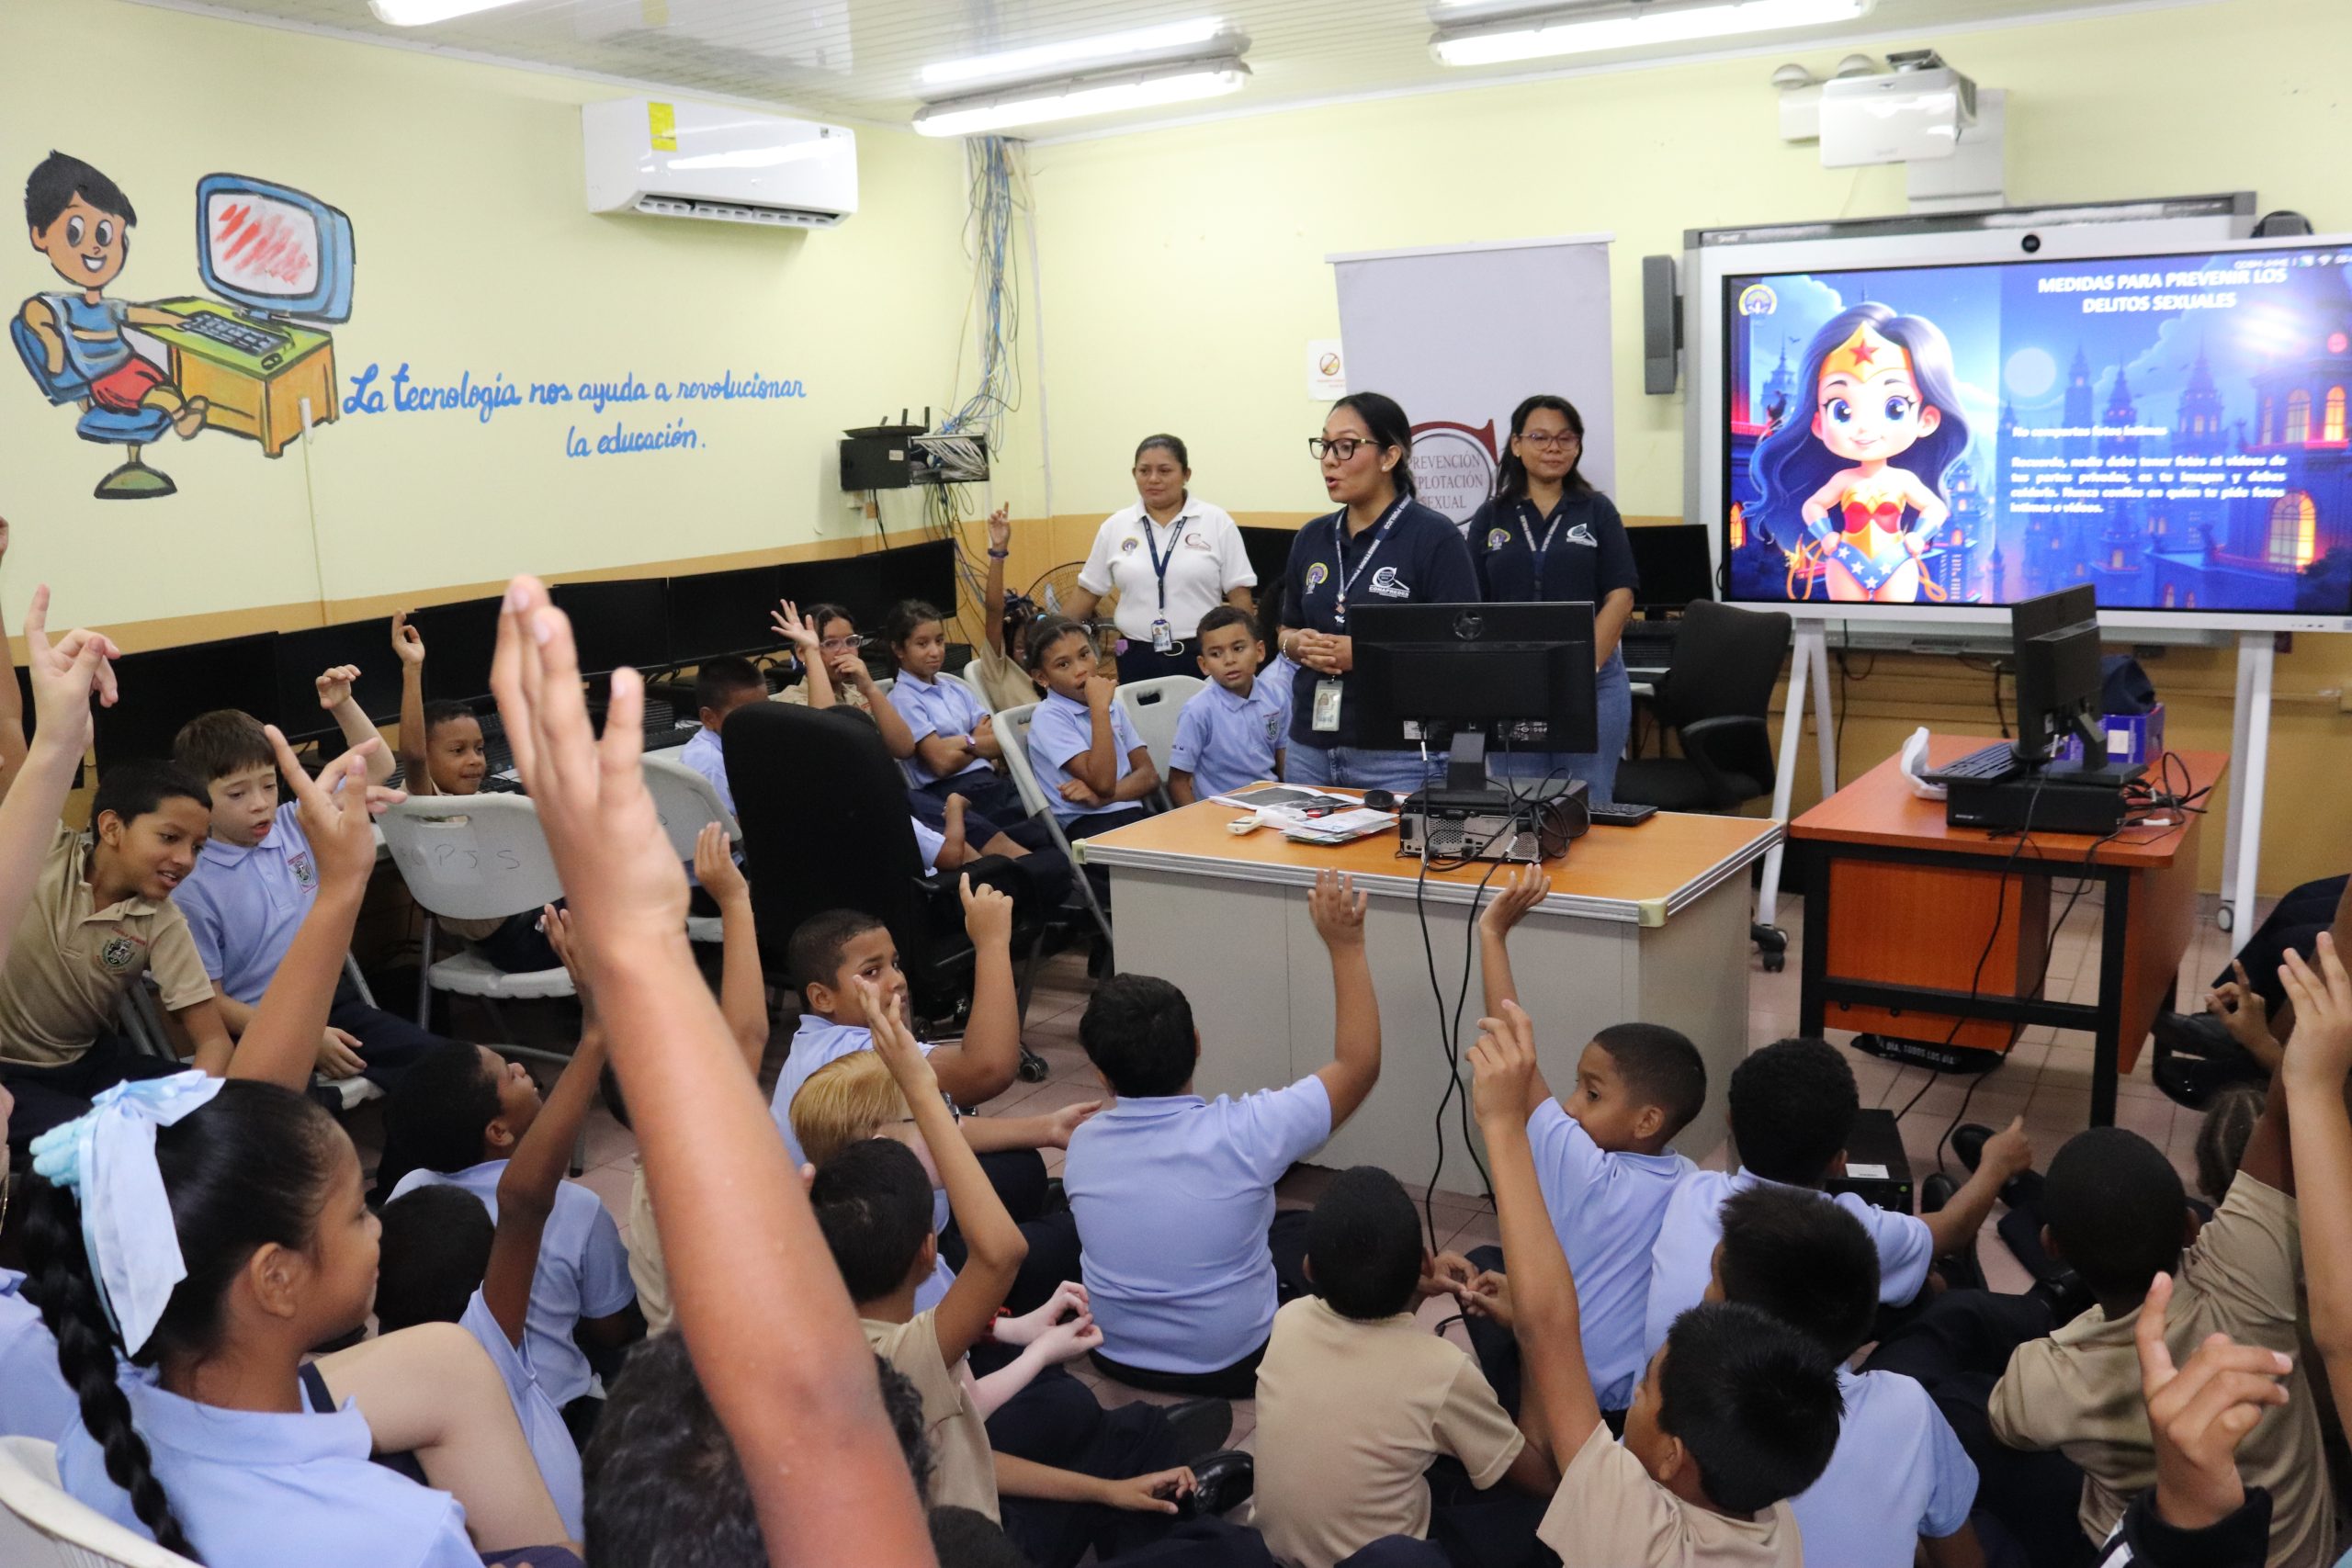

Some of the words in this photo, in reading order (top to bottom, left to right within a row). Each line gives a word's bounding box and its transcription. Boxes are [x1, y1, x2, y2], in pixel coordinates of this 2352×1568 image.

[2038, 275, 2114, 293] MEDIDAS
[2117, 273, 2162, 289] PARA
[2165, 269, 2250, 288] PREVENIR
[2253, 267, 2288, 284] LOS
[2082, 296, 2150, 313] DELITOS
[2153, 292, 2236, 311] SEXUALES
[343, 363, 388, 414] La
[529, 382, 573, 404] nos
[578, 371, 650, 413] ayuda
[655, 382, 673, 402] a
[676, 369, 807, 400] revolucionar
[566, 425, 593, 457] la
